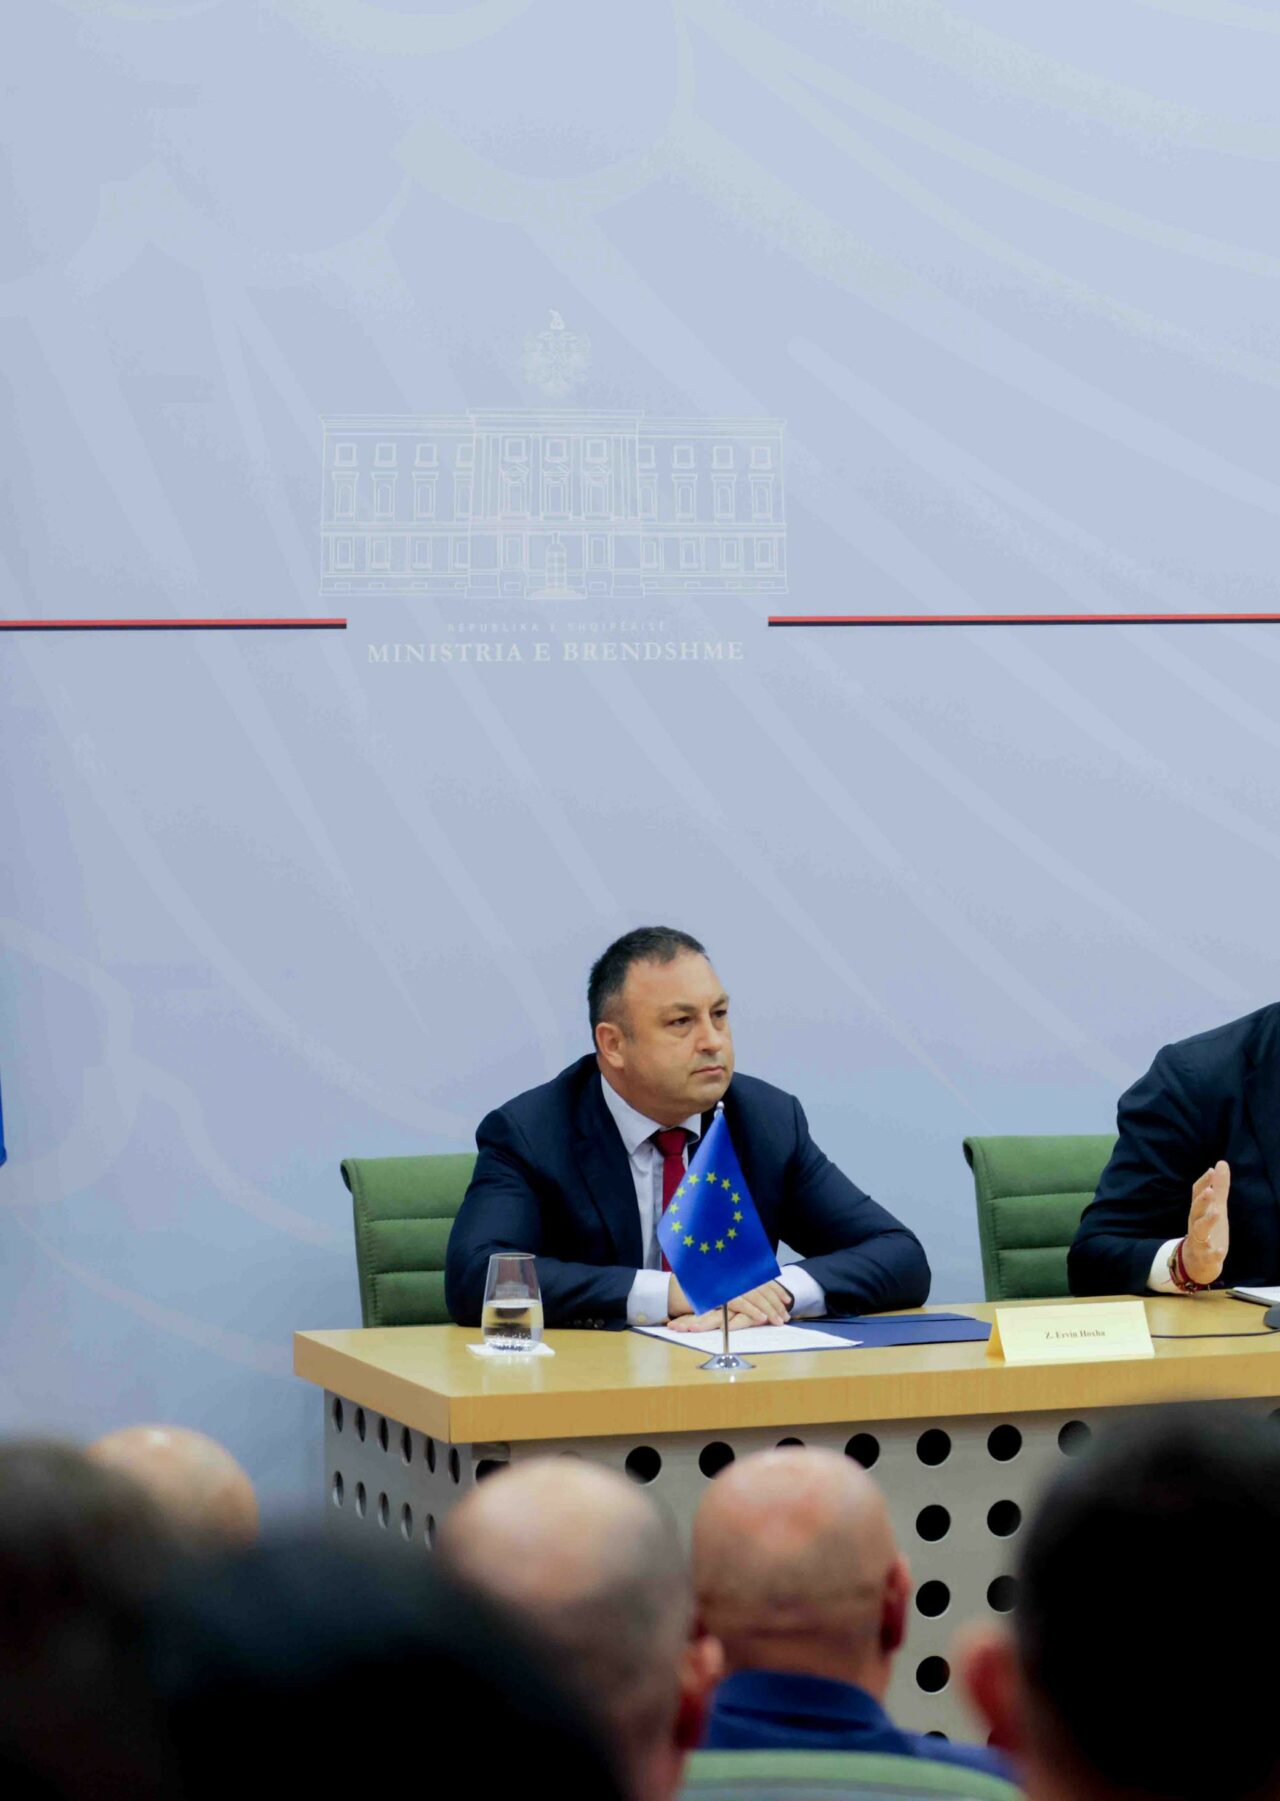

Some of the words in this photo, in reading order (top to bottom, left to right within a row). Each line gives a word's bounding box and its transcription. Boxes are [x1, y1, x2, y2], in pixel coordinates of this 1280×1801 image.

[447, 622, 539, 633] REPUBLIKA
[367, 643, 523, 663] MINISTRIA
[534, 642, 551, 661] E
[563, 641, 744, 662] BRENDSHME
